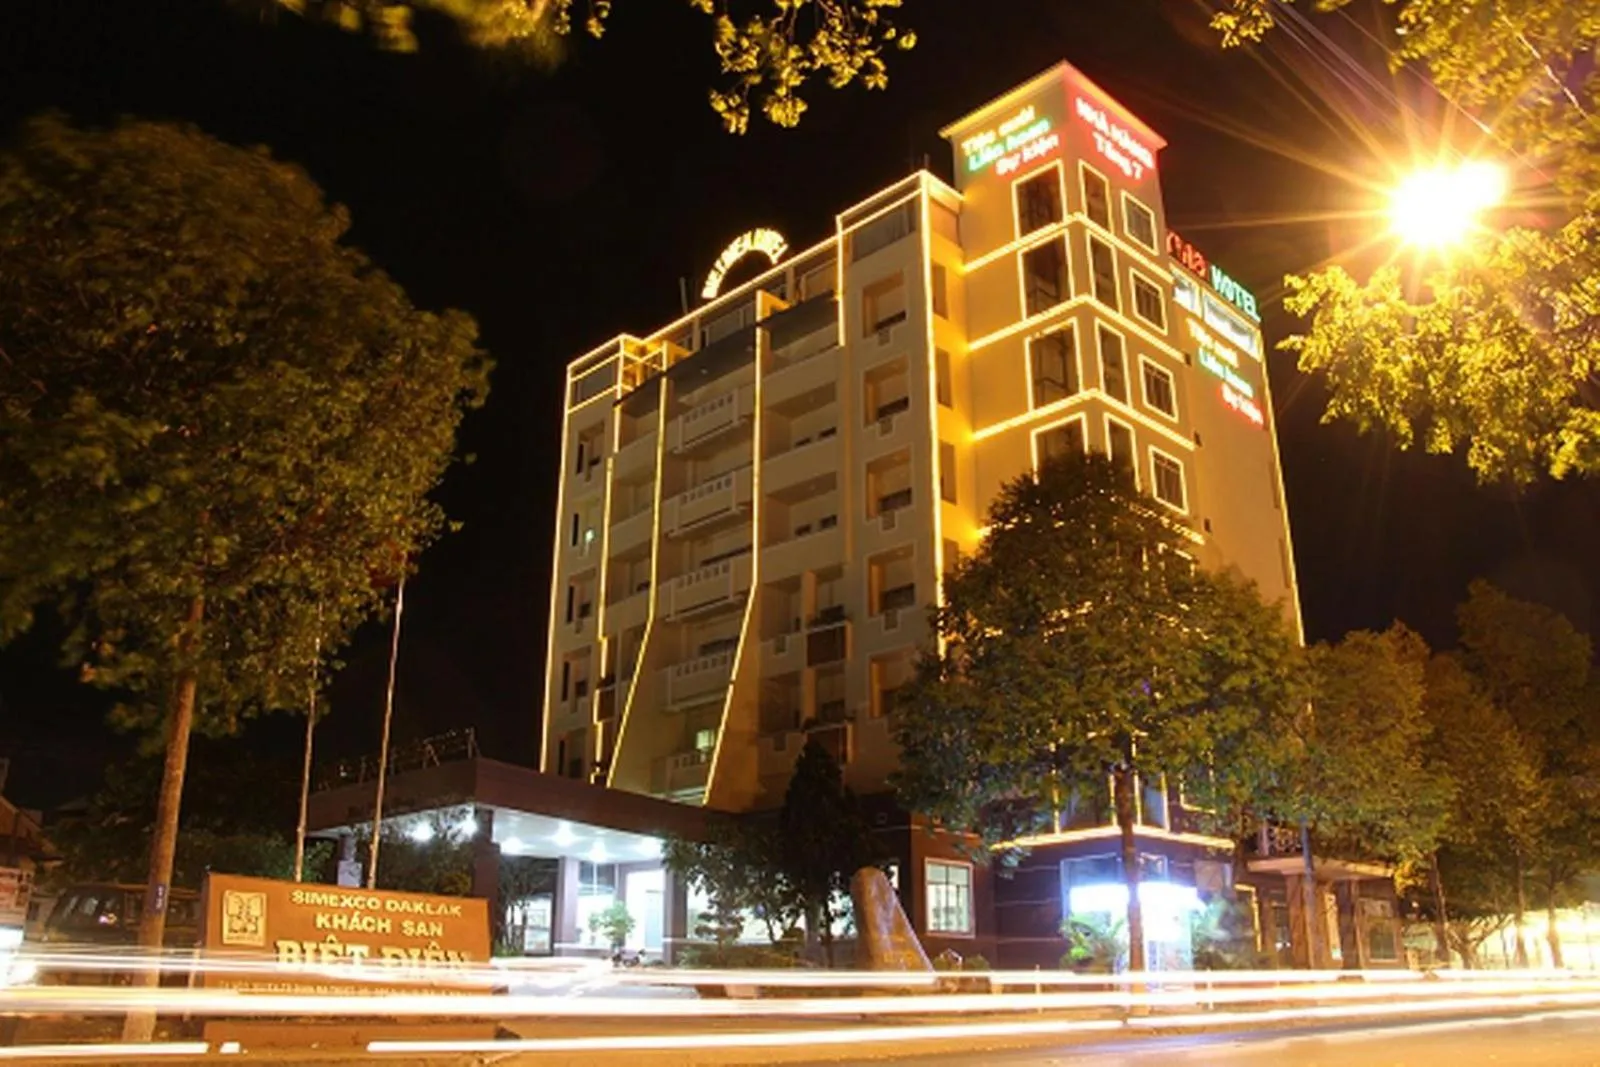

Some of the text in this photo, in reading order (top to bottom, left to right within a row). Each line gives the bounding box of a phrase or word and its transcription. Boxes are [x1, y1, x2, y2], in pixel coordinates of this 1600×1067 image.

[1211, 265, 1262, 323] HOTEL
[291, 889, 381, 910] SIMEXCO
[315, 911, 392, 933] KHÁCH
